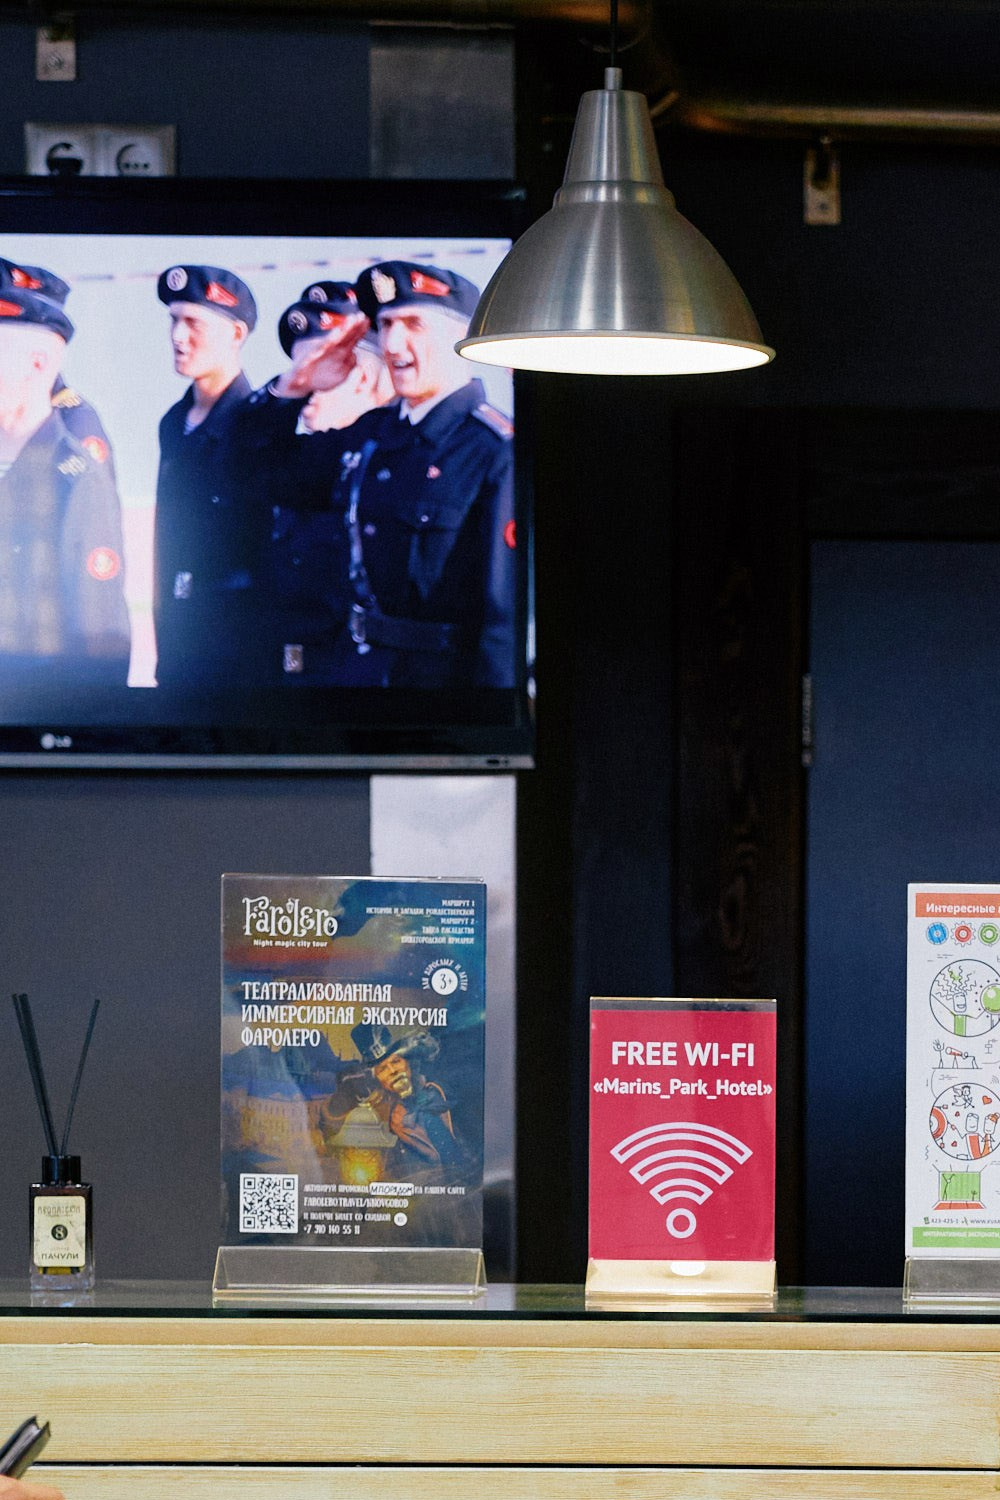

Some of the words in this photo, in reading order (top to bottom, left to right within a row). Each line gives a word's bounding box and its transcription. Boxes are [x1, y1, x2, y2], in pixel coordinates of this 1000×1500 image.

[242, 895, 338, 937] Farolero
[926, 902, 996, 914] Интересные
[253, 939, 273, 947] Night
[275, 940, 295, 948] magic
[440, 973, 452, 990] 3+
[242, 982, 392, 1002] ТЕАТРАЛИЗОВАННАЯ
[242, 1005, 354, 1025] ИММЕРСИВНАЯ
[362, 1007, 448, 1026] ЭКСКУРСИЯ
[242, 1029, 320, 1048] ФАРОЛЕРО
[611, 1041, 678, 1066] FREE
[685, 1042, 755, 1067] WI-FI
[593, 1077, 773, 1100] «Marins_Park_Hotel»
[55, 1226, 64, 1238] 8
[342, 1225, 352, 1234] 55
[42, 1252, 79, 1260] ПАЧУЛИ
